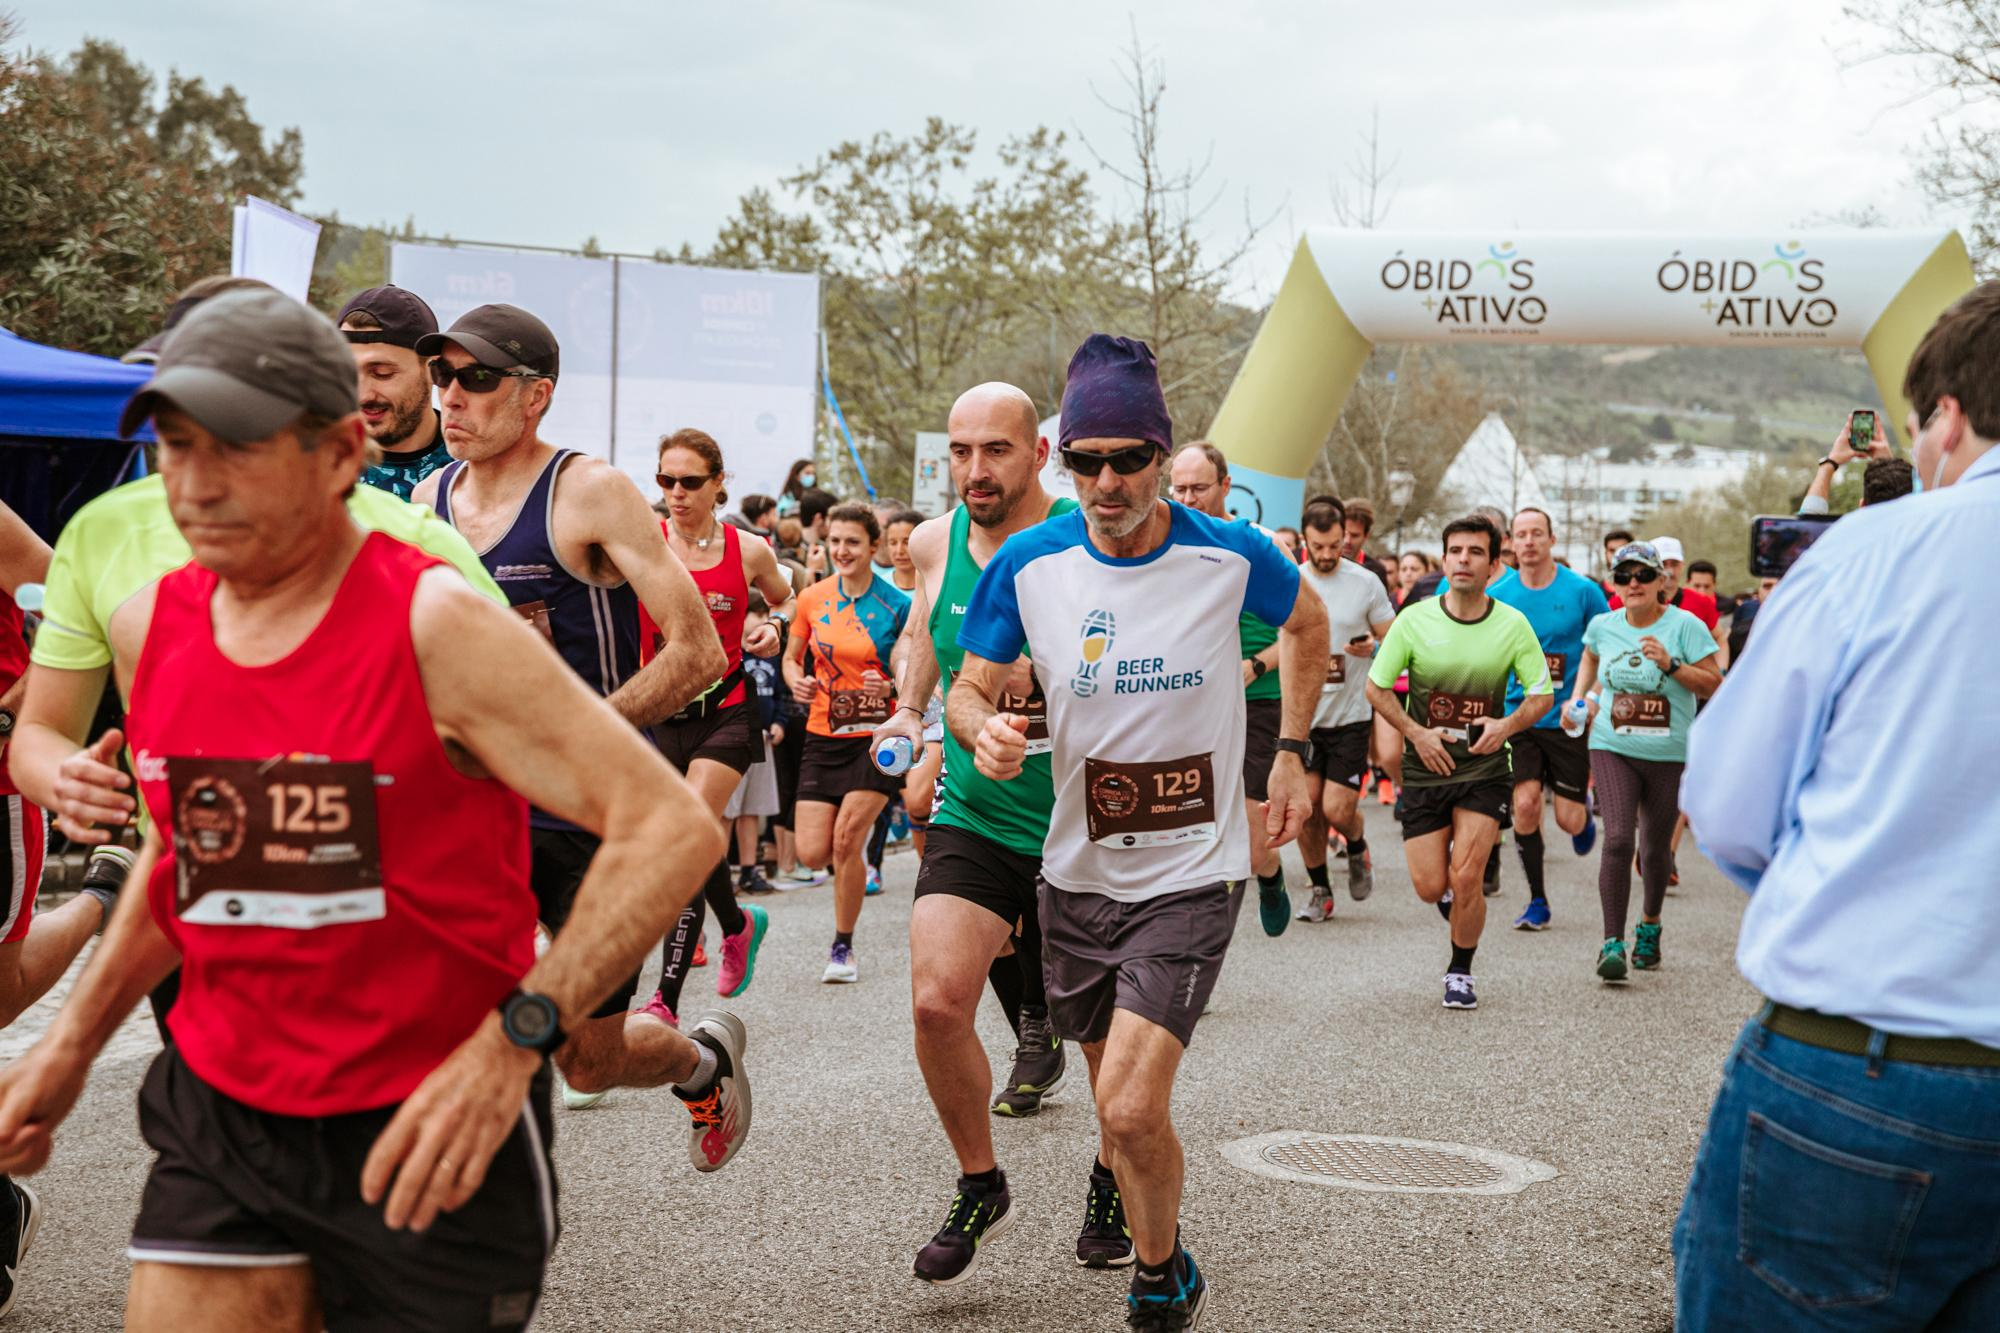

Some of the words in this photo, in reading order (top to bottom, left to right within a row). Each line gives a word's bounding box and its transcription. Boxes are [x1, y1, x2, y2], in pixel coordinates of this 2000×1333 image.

[1117, 657, 1164, 676] BEER
[1114, 669, 1204, 695] RUNNERS
[1462, 701, 1484, 715] 211
[1643, 700, 1662, 713] 171
[1153, 768, 1201, 797] 129
[266, 784, 351, 833] 125
[1150, 804, 1177, 814] 10km
